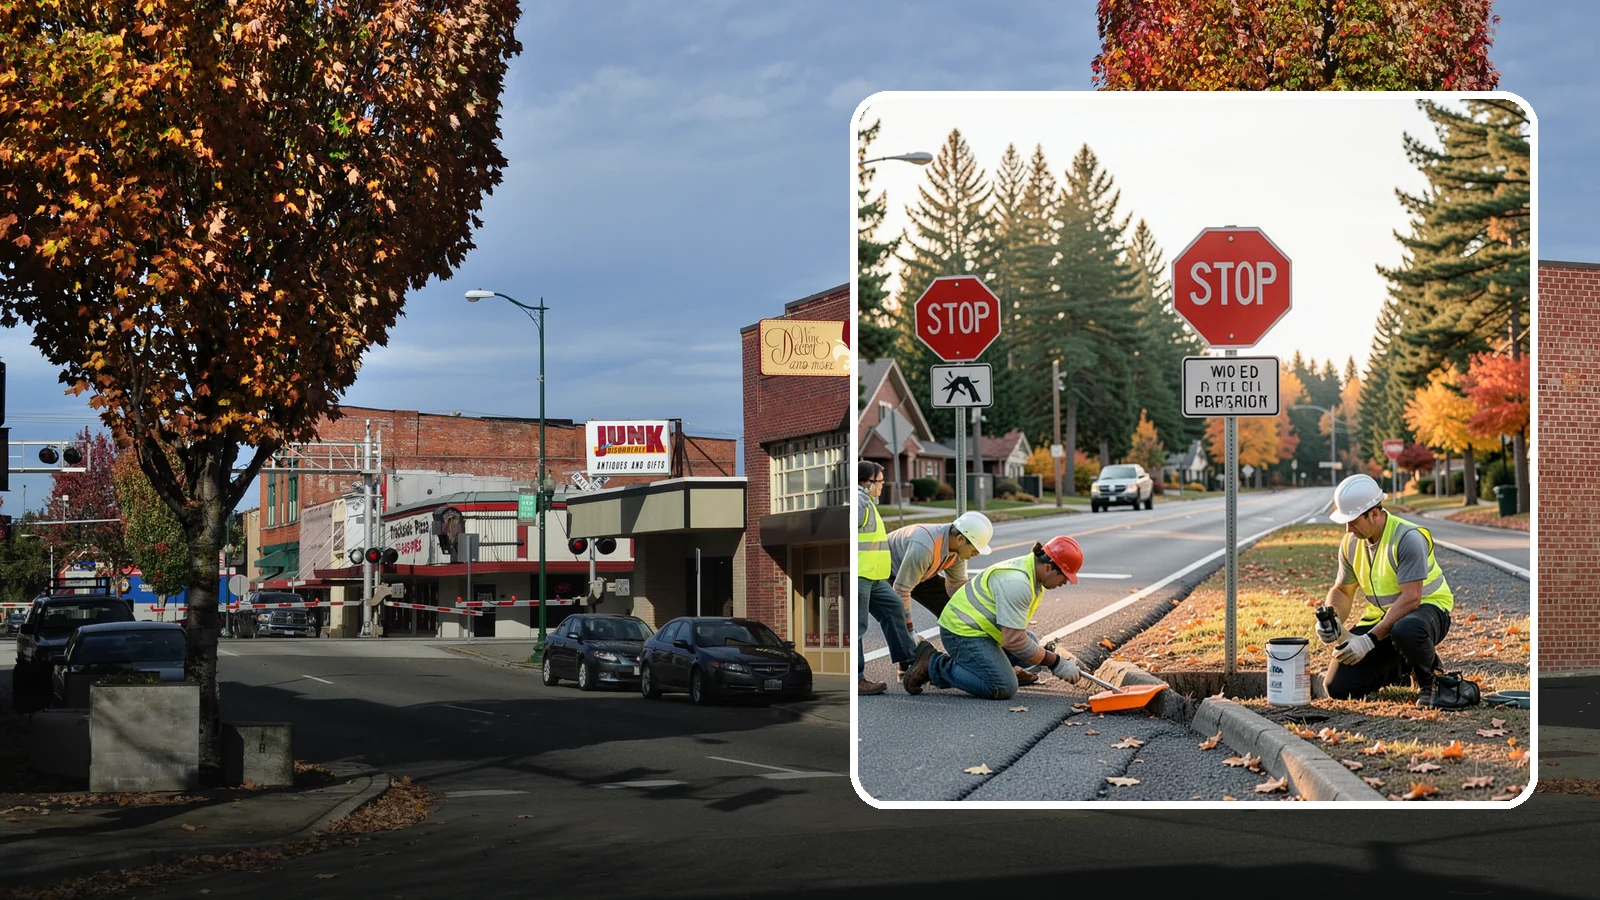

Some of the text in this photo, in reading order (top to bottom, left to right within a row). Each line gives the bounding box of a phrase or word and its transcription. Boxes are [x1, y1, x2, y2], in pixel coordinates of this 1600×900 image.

[1189, 261, 1278, 306] STOP
[927, 301, 990, 335] STOP
[595, 425, 665, 457] JUNK
[607, 446, 646, 454] DISORDERLY
[597, 460, 665, 470] ANTIQUES AND GIFTS
[415, 519, 429, 535] Pizza
